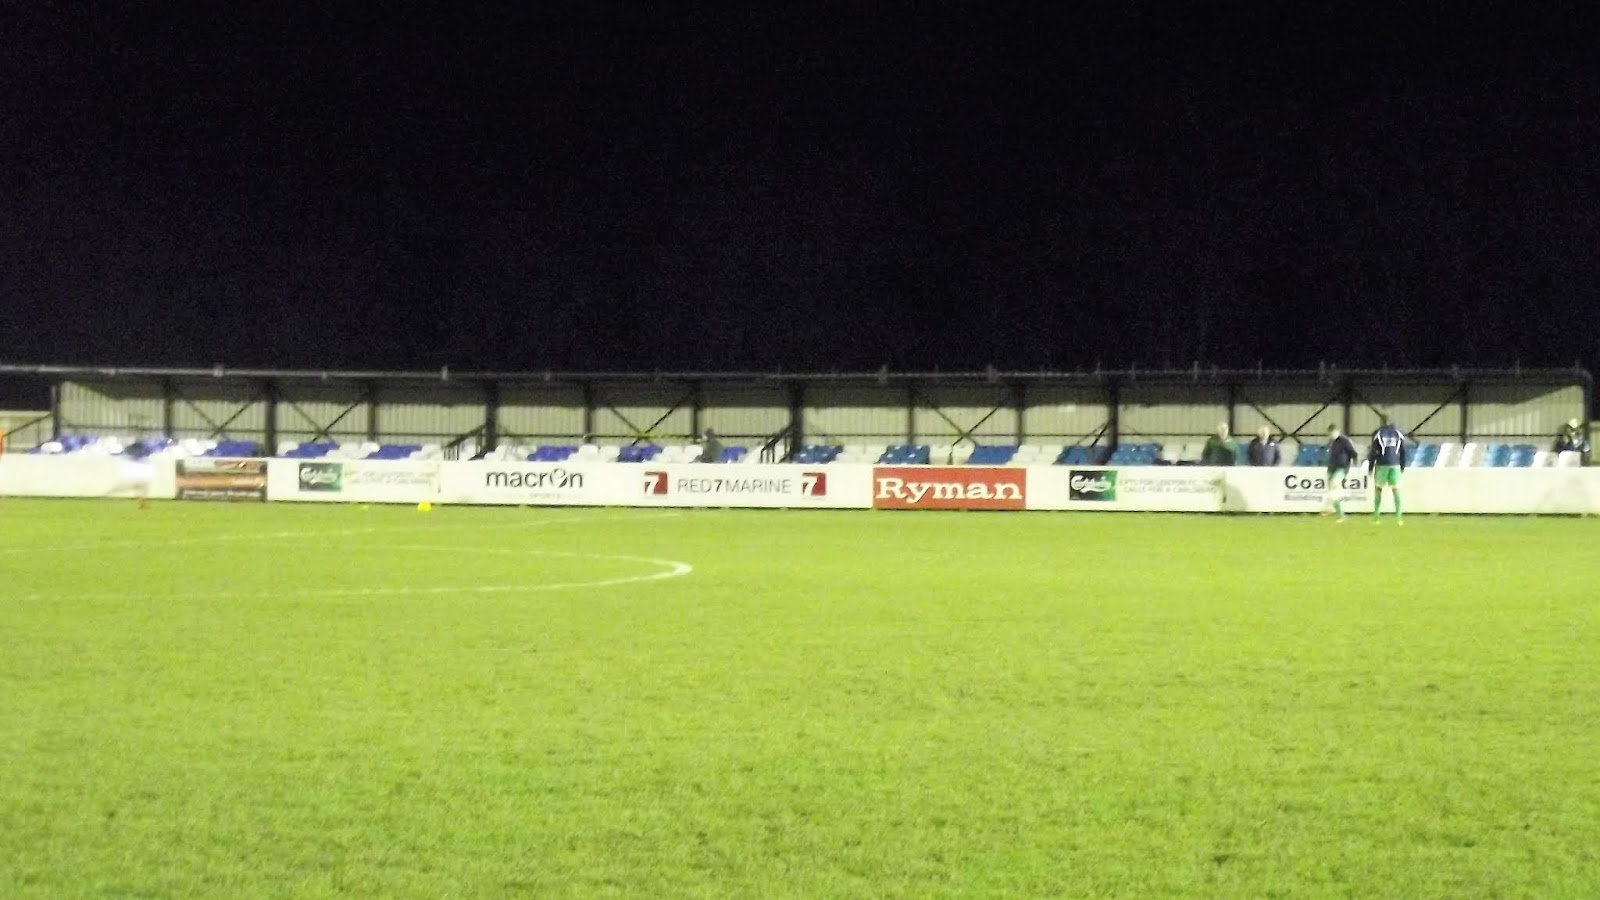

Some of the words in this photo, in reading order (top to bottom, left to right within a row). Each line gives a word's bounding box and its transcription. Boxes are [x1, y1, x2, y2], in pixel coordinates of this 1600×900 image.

[486, 468, 583, 488] macron
[644, 472, 661, 495] 7
[802, 473, 819, 496] 7
[1284, 474, 1368, 491] Coatal
[876, 477, 1023, 503] Ryman
